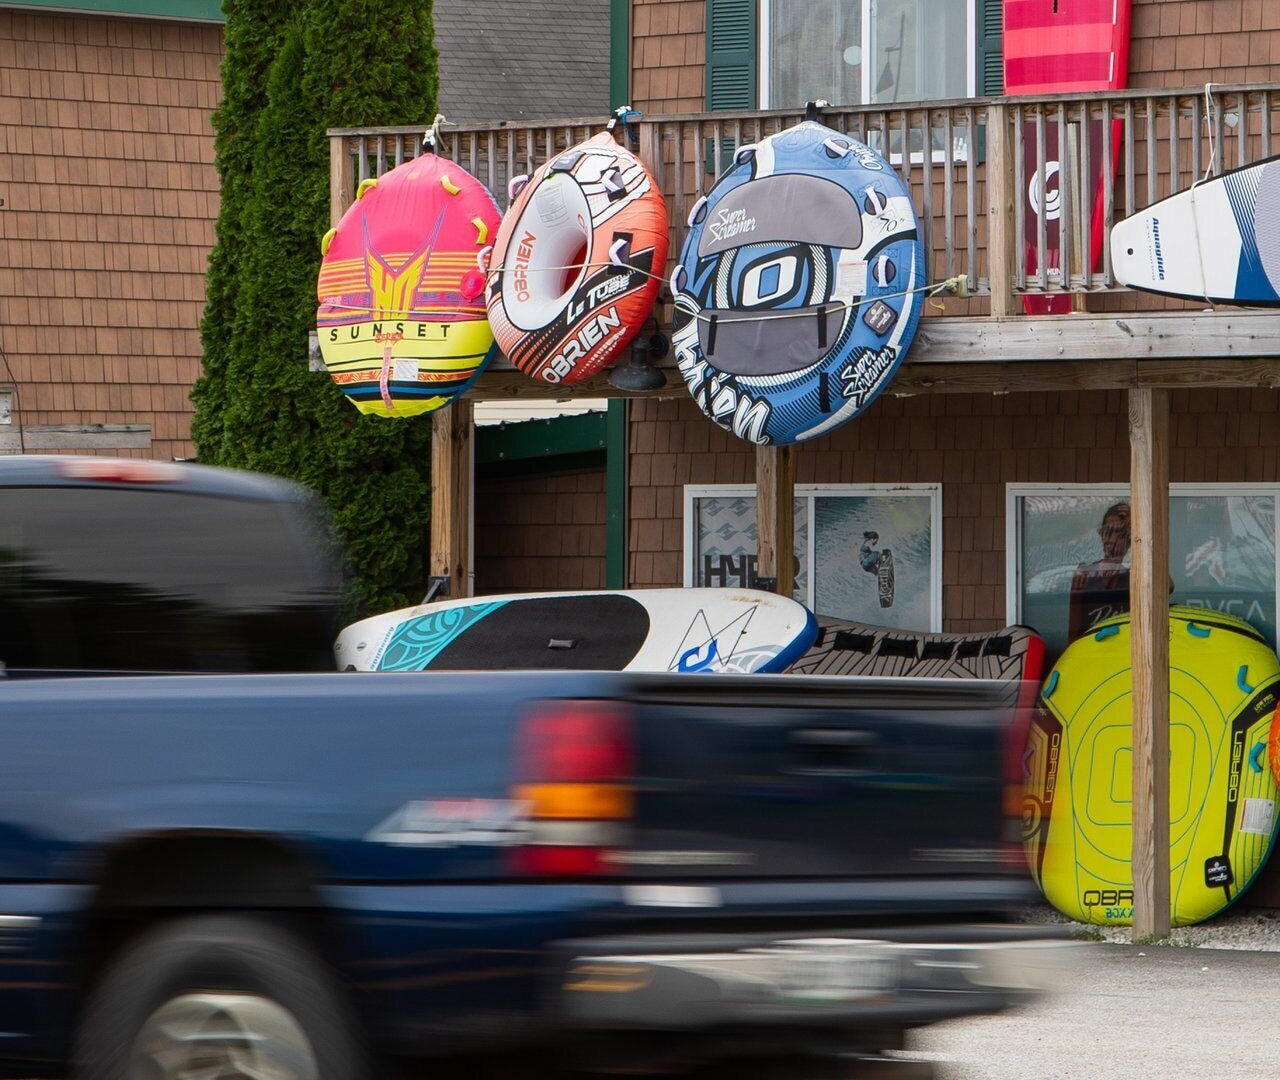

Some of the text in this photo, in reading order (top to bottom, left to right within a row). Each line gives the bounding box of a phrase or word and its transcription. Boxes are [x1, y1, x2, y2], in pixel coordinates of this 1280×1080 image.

[513, 230, 538, 303] OBRIEN
[1152, 217, 1165, 281] Aquaglide
[329, 322, 451, 342] SUNSET
[541, 306, 621, 384] OBRIEN
[1043, 732, 1061, 804] OBRIEN
[1227, 729, 1244, 803] OBRIEN
[1083, 890, 1134, 907] OBR
